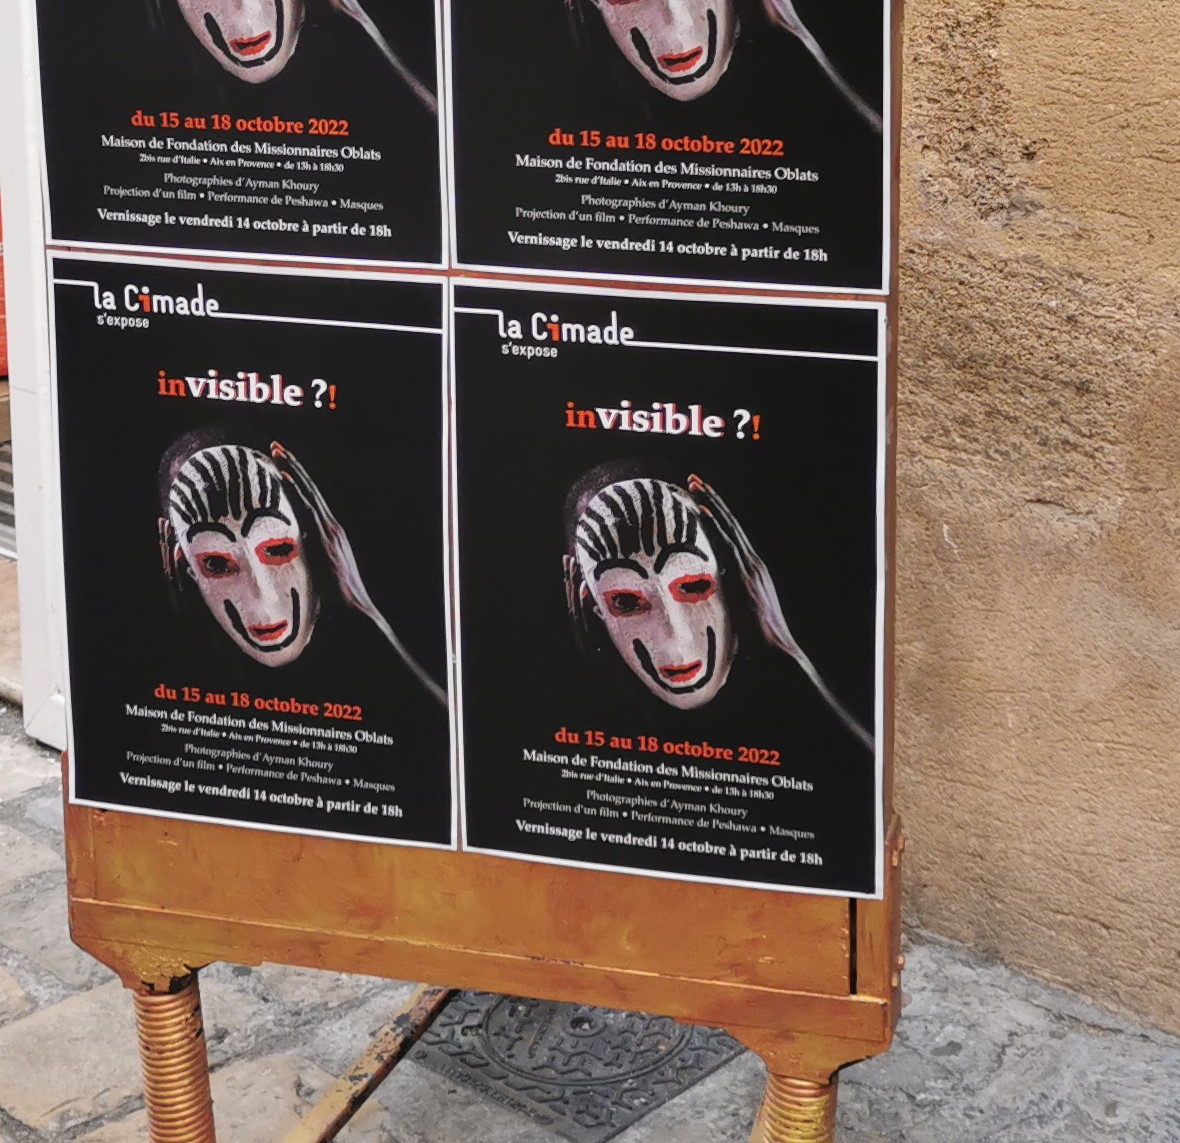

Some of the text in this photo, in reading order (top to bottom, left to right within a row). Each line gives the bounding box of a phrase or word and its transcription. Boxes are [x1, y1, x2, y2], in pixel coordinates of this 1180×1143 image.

[131, 110, 348, 135] du 15 au 18 octobre 2022
[101, 135, 381, 160] Maison de Fondation des Missionnaires Oblats
[549, 128, 784, 156] du 15 au 18 octobre 2022
[516, 154, 818, 181] Maison de Fondation des Missionnaires Oblats
[104, 185, 383, 211] Projection d'un film Performance de Peshawa Masques
[164, 173, 319, 194] Photographies d'Ayman Khoury
[581, 194, 750, 216] Photographies d'Ayman Khoury
[97, 208, 392, 237] Vernissage le vendredi 14 octobre à partir de 18h
[516, 207, 819, 235] Projection d'un film Performance de Peshawa Masques
[508, 231, 827, 261] Vernissage le vendredi 14 octobre à partir de 18h
[91, 282, 221, 317] la Cimade
[98, 314, 149, 329] s'expose
[496, 310, 636, 346] la Cimade
[502, 342, 557, 359] s'expose
[158, 370, 336, 409] invisible ?!
[566, 401, 760, 439] invisible ?!
[155, 684, 362, 720] du 15 au 18 octobre 2022
[126, 704, 393, 745] Maison de Fondation des Missionnaires Oblats
[555, 727, 780, 765] du 15 au 18 octobre 2022
[524, 749, 813, 791] Maison de Fondation des Missionnaires Oblats
[120, 772, 403, 817] Vernissage le vendredi 14 octobre à partir de 18h
[516, 819, 822, 865] Vernissage le vendredi 14 octobre à partir de 18h
